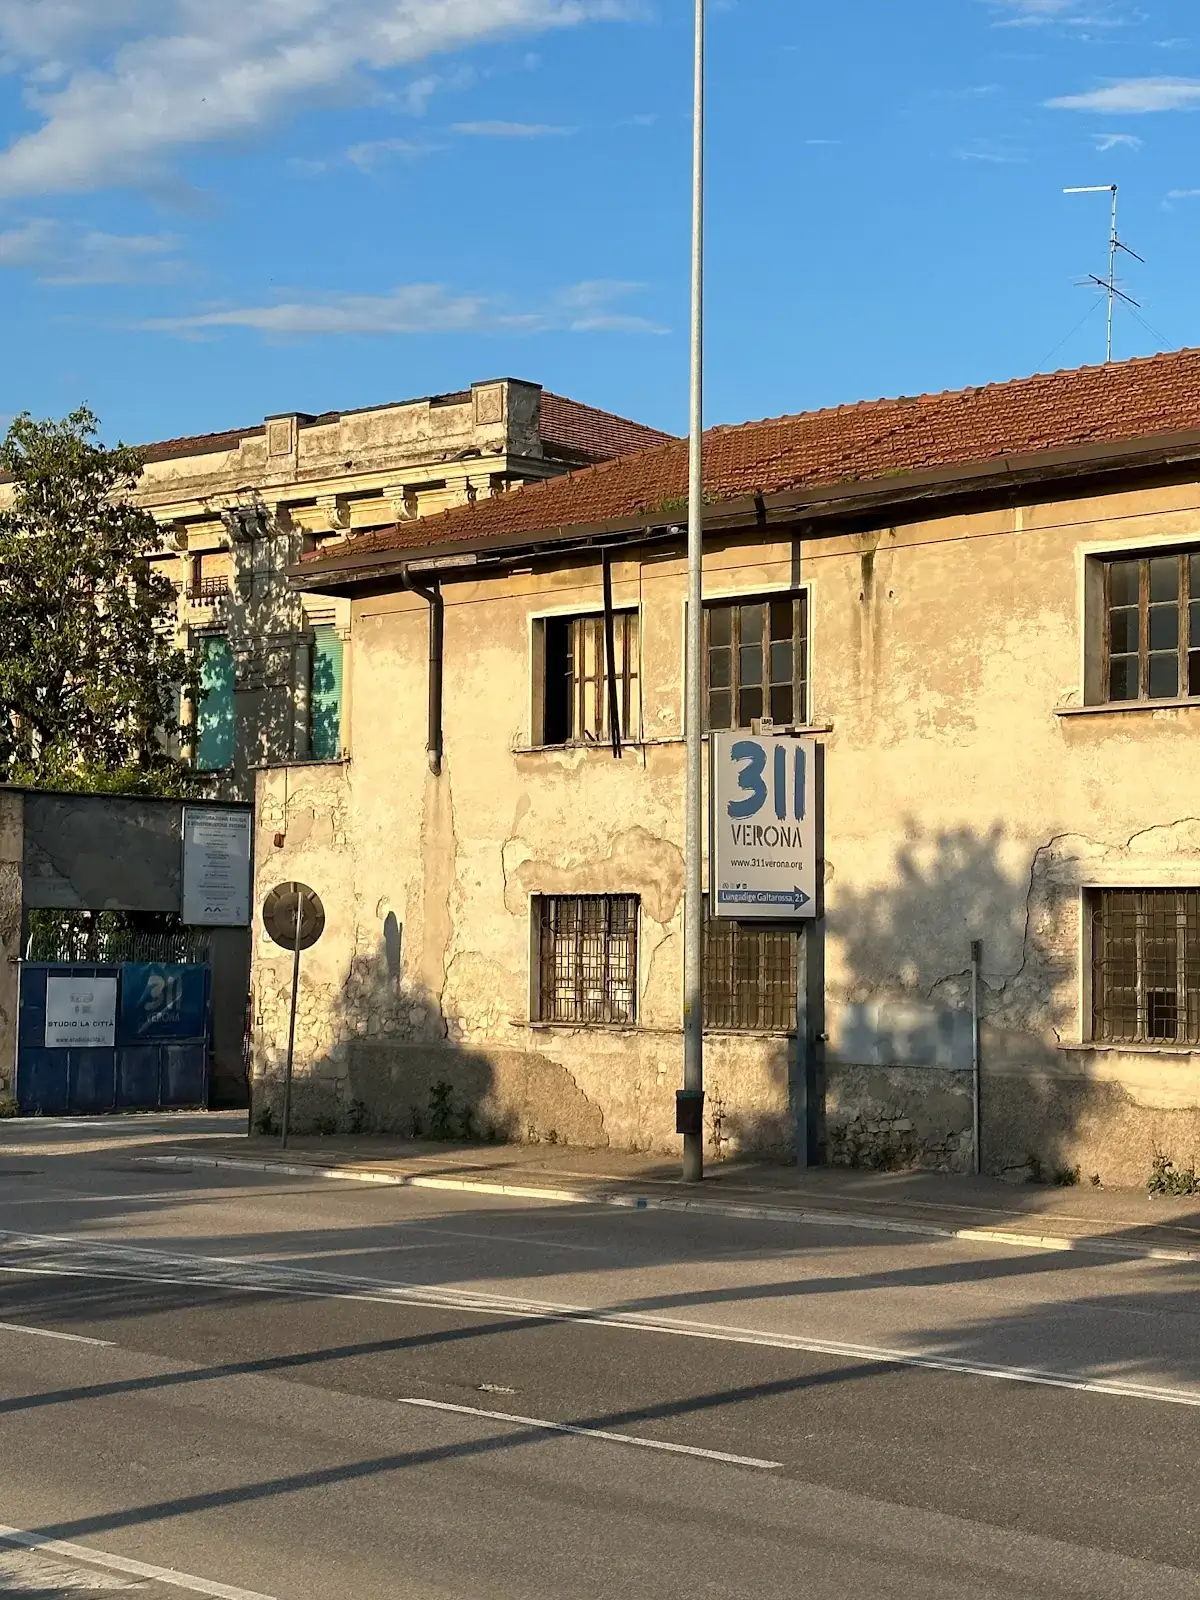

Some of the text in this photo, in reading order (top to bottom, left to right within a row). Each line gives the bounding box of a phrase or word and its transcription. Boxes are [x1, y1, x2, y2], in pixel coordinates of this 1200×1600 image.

[727, 740, 807, 823] 311
[731, 824, 803, 848] VERONA
[731, 858, 803, 871] www.311verona.org
[722, 891, 756, 902] Lungadige
[795, 893, 804, 903] 21
[144, 975, 183, 1010] 311
[93, 1019, 114, 1027] CITTÀ
[147, 1012, 180, 1023] VERONA
